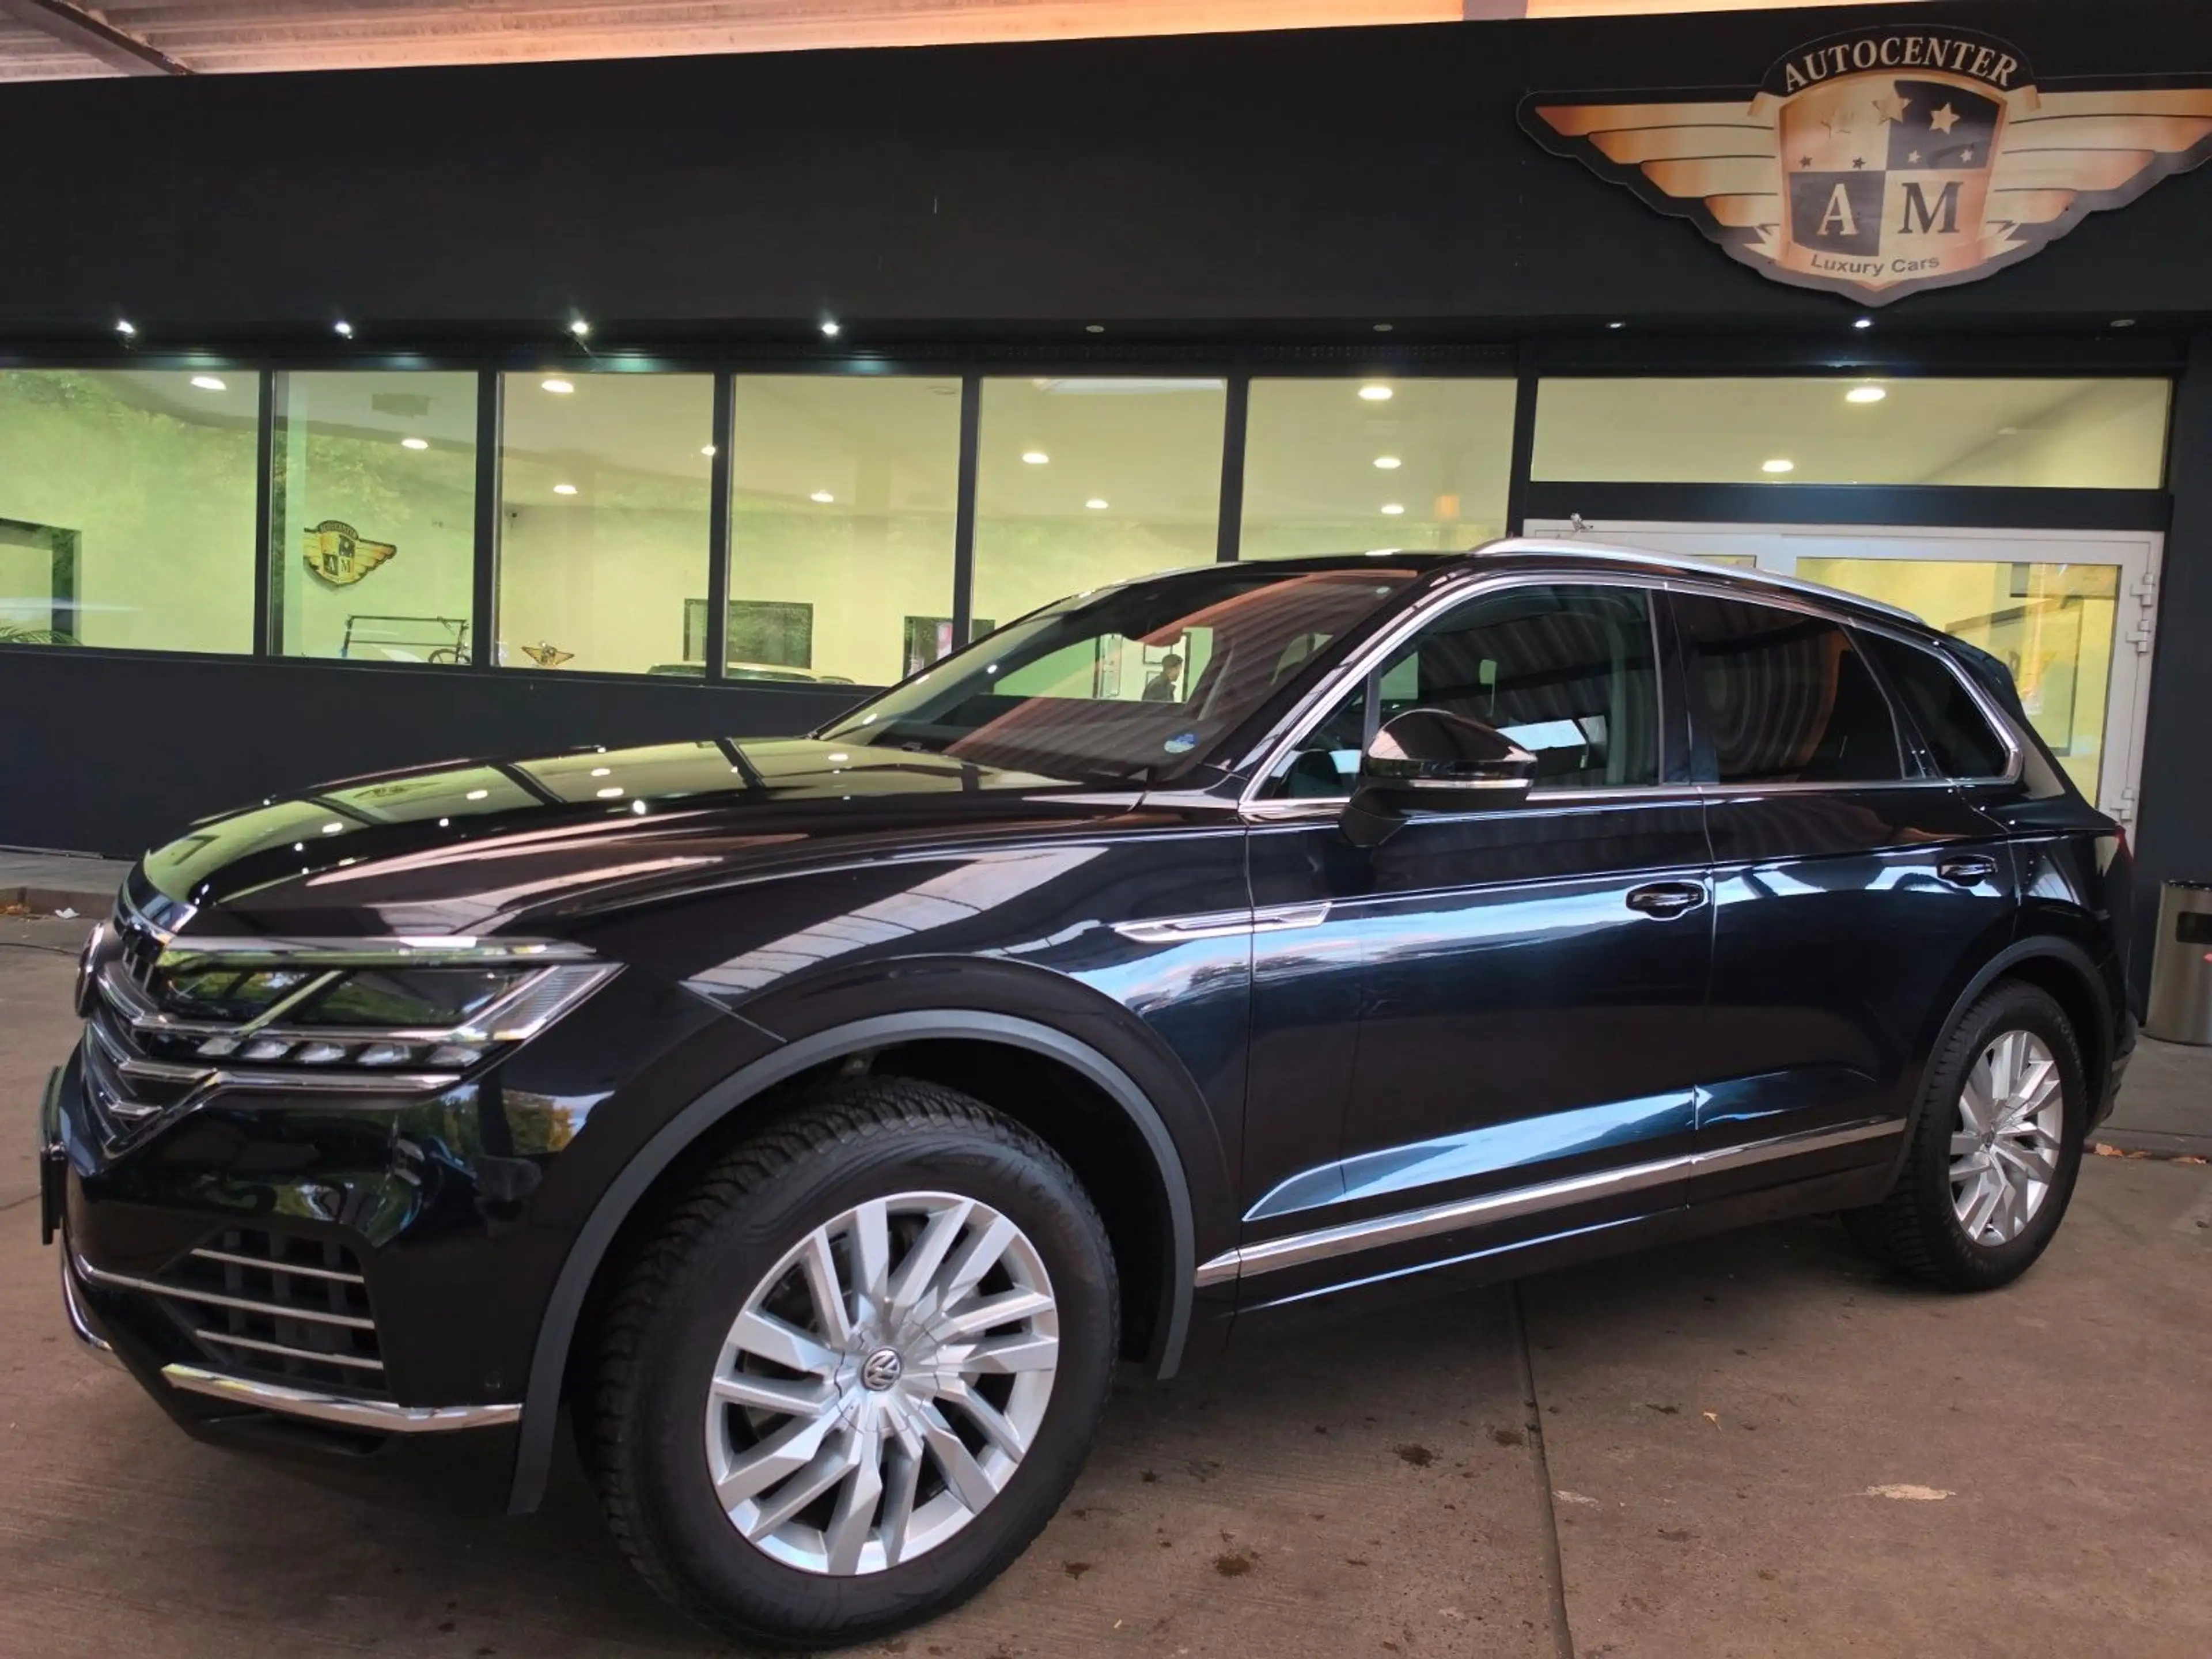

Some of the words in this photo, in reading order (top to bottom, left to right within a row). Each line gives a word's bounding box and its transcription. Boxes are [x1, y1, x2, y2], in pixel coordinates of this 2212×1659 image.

[1785, 36, 2019, 93] AUTOCENTER
[1817, 183, 1858, 236] A
[1897, 181, 1964, 234] M
[1810, 254, 1884, 277] Luxury
[1891, 257, 1940, 273] Cars
